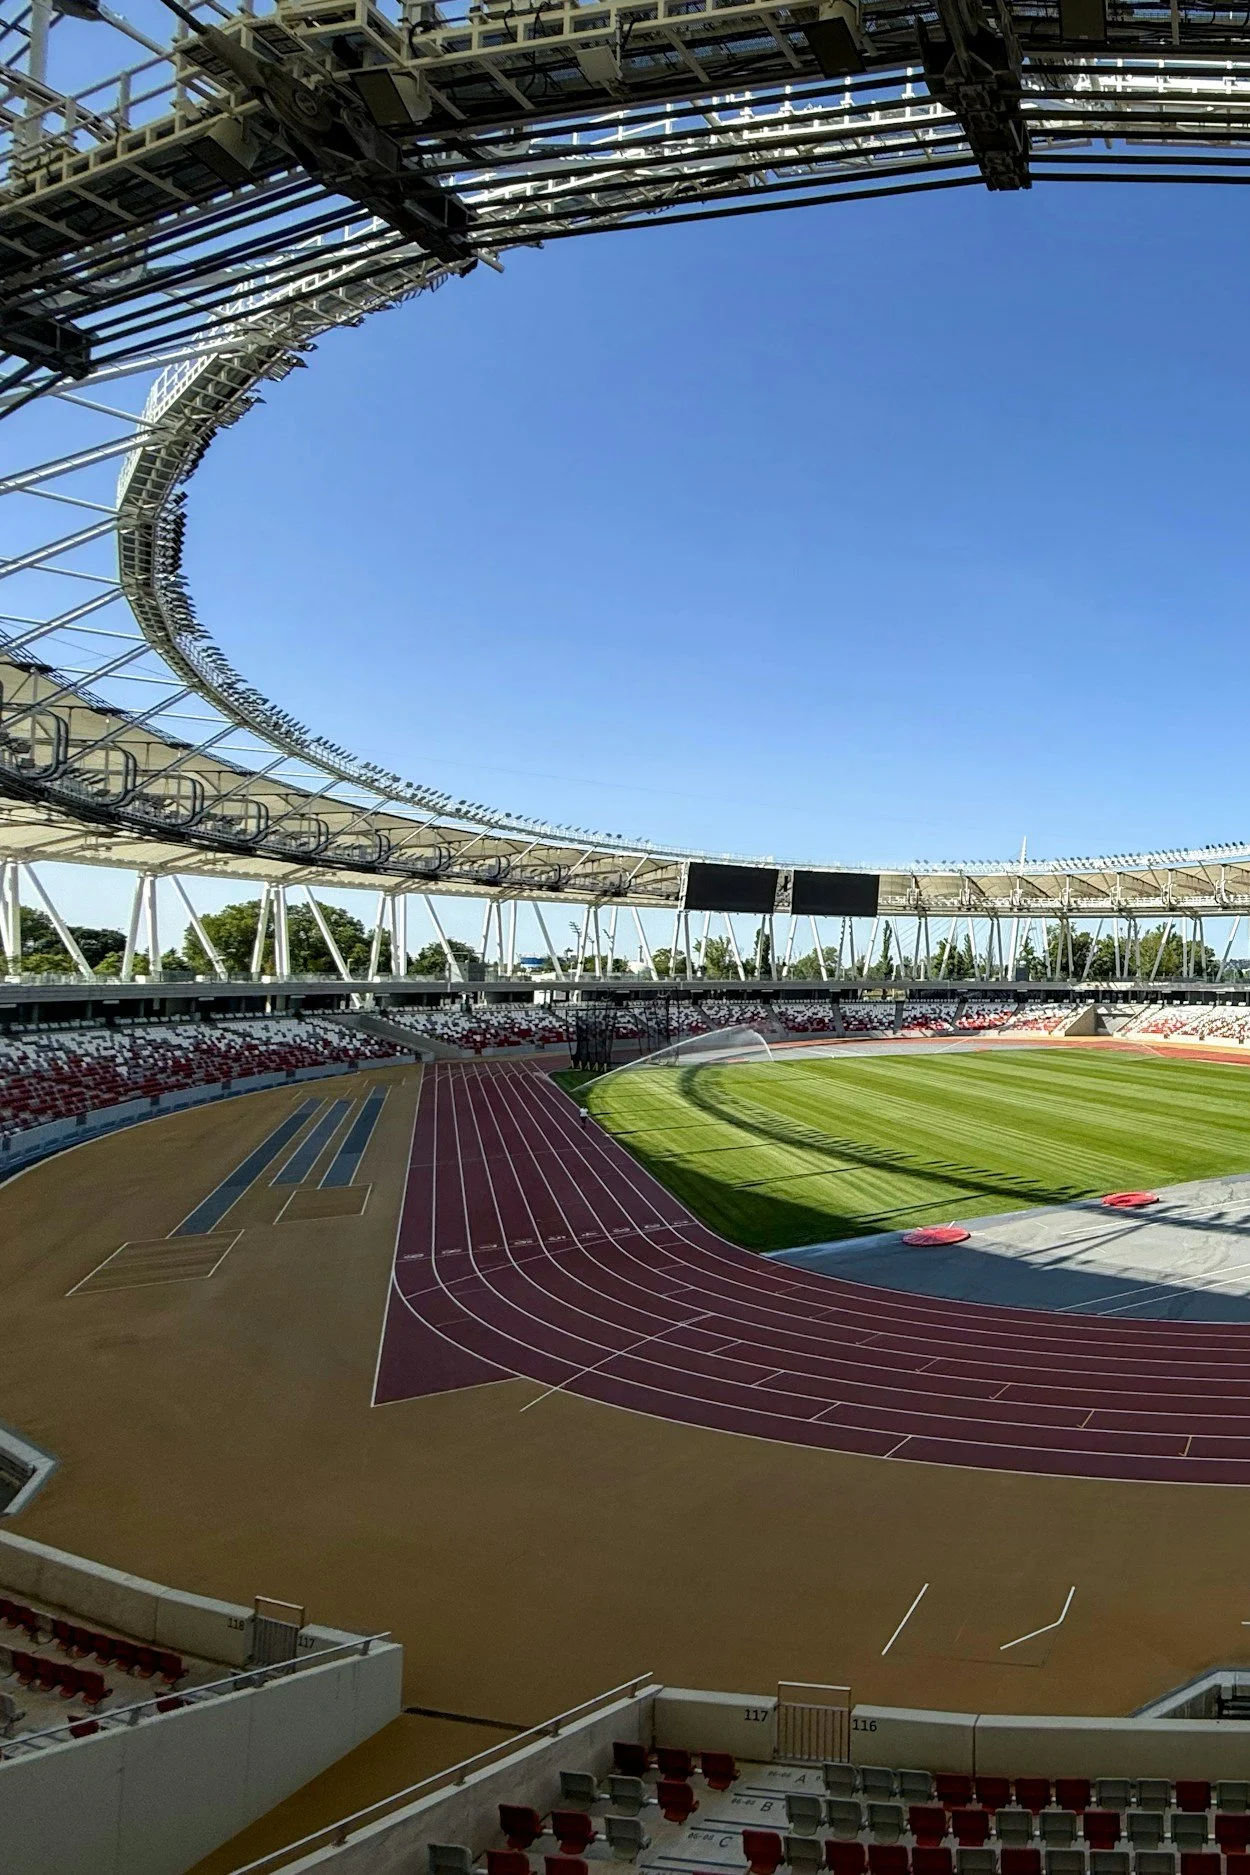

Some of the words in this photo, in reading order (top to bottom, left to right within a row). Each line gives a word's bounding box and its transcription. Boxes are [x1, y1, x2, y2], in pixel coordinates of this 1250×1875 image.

[744, 1709, 768, 1722] 117
[852, 1719, 877, 1732] 116
[794, 1774, 806, 1784] A
[760, 1801, 774, 1812] B
[719, 1836, 733, 1847] C
